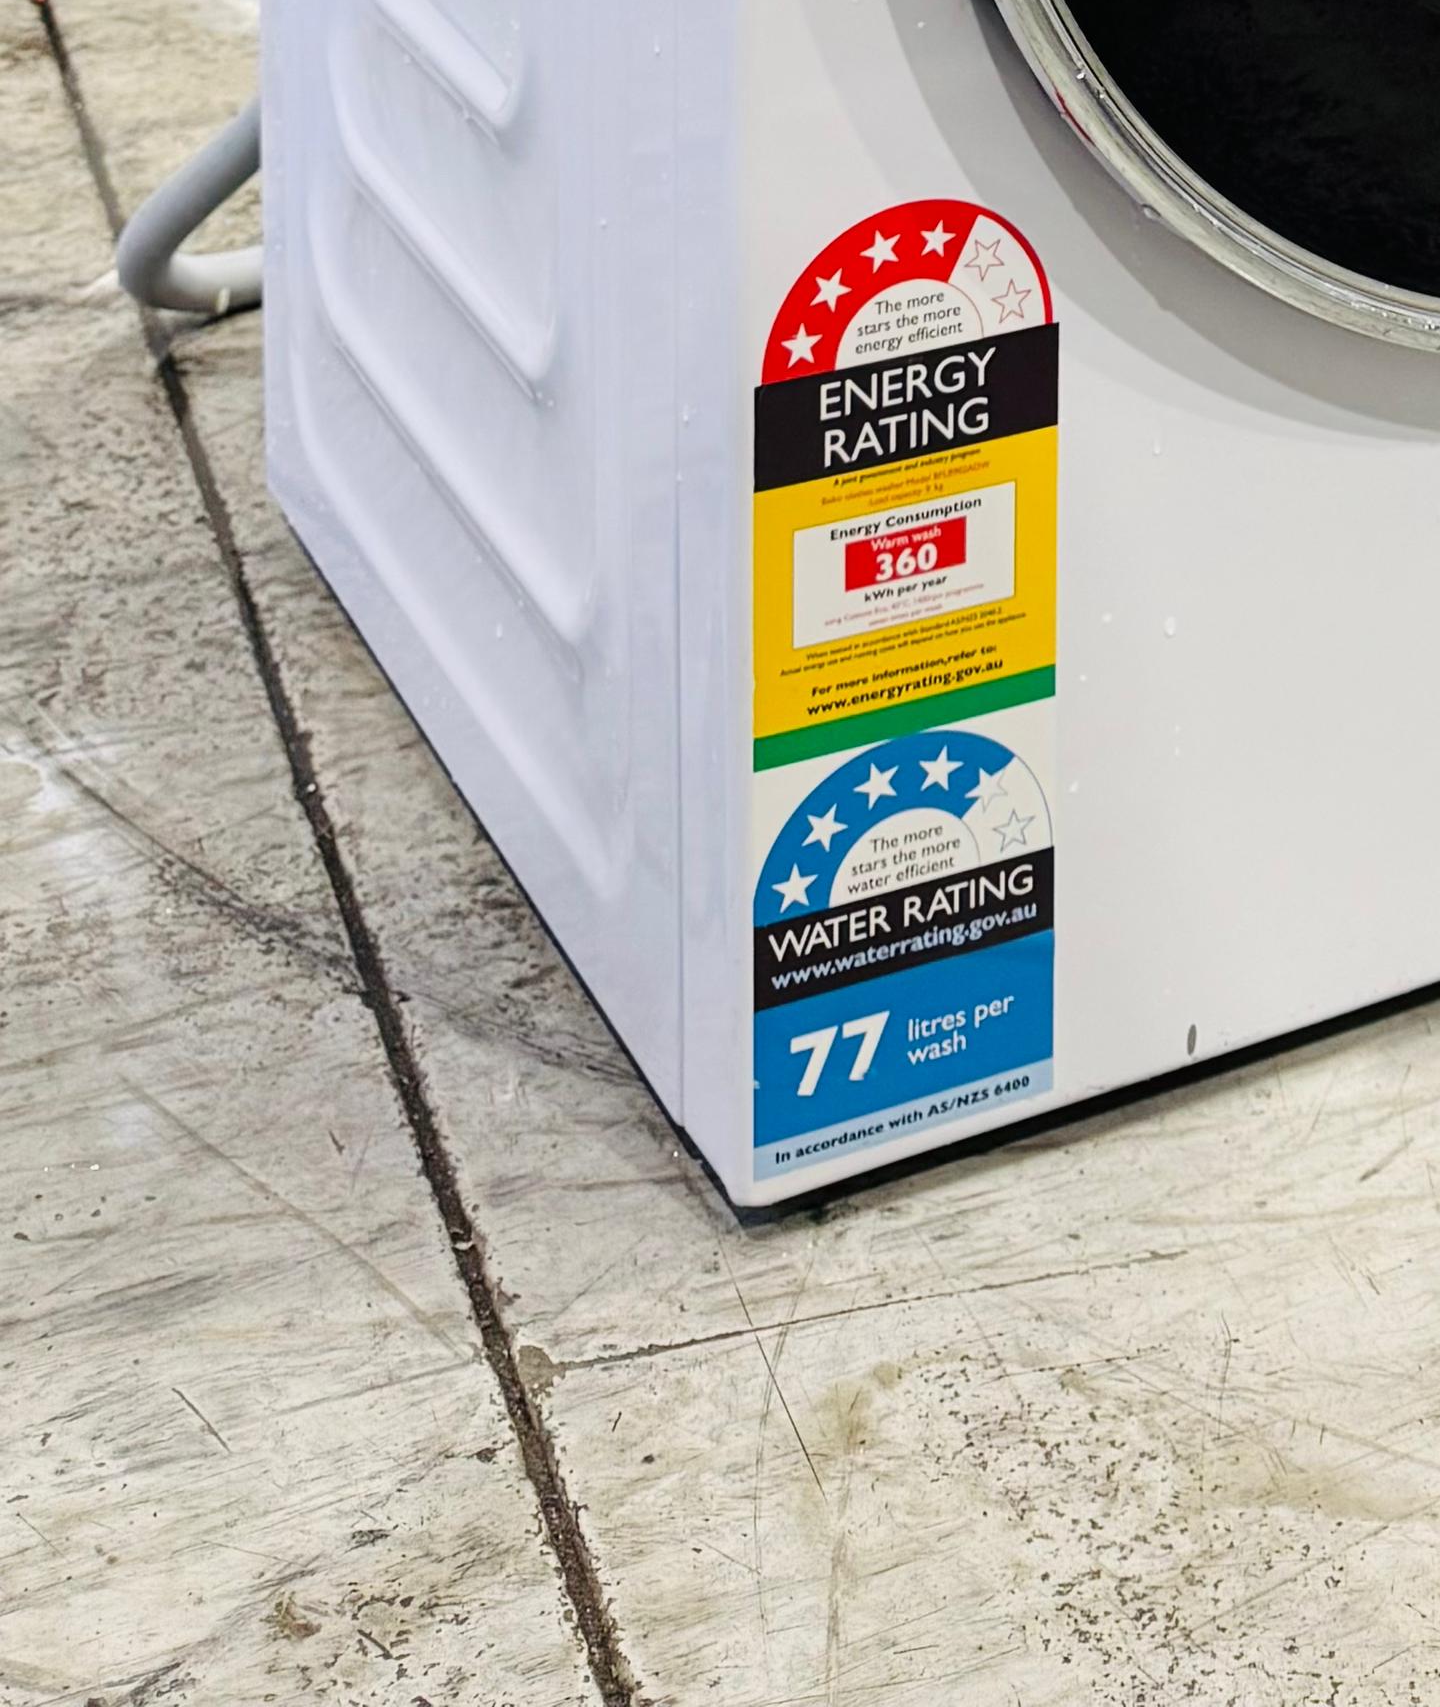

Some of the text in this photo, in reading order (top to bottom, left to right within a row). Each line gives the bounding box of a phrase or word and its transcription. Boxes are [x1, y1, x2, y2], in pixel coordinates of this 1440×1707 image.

[857, 306, 961, 337] stars the more
[875, 292, 944, 315] The more
[855, 322, 963, 354] energy efficient
[820, 347, 996, 421] ENERGY
[824, 397, 989, 468] RATING
[831, 497, 981, 541] Energy Consumption
[871, 526, 941, 553] Warm wash
[875, 543, 937, 582] 360
[865, 586, 894, 602] kWh
[898, 582, 918, 597] per
[922, 575, 947, 592] year
[807, 659, 1003, 716] www.energyrating.gov.au
[811, 685, 831, 697] For
[836, 676, 869, 691] more
[852, 838, 961, 876] stars the more
[871, 826, 943, 853] The more
[848, 856, 954, 894] water efficient
[769, 864, 1033, 962] WATER RATING
[771, 903, 1037, 990] www.waterrating.gov.au
[791, 996, 1014, 1096] 77 litres per
[907, 1032, 966, 1066] wash
[776, 1076, 1030, 1164] In accordance with AS/NZS 6400
